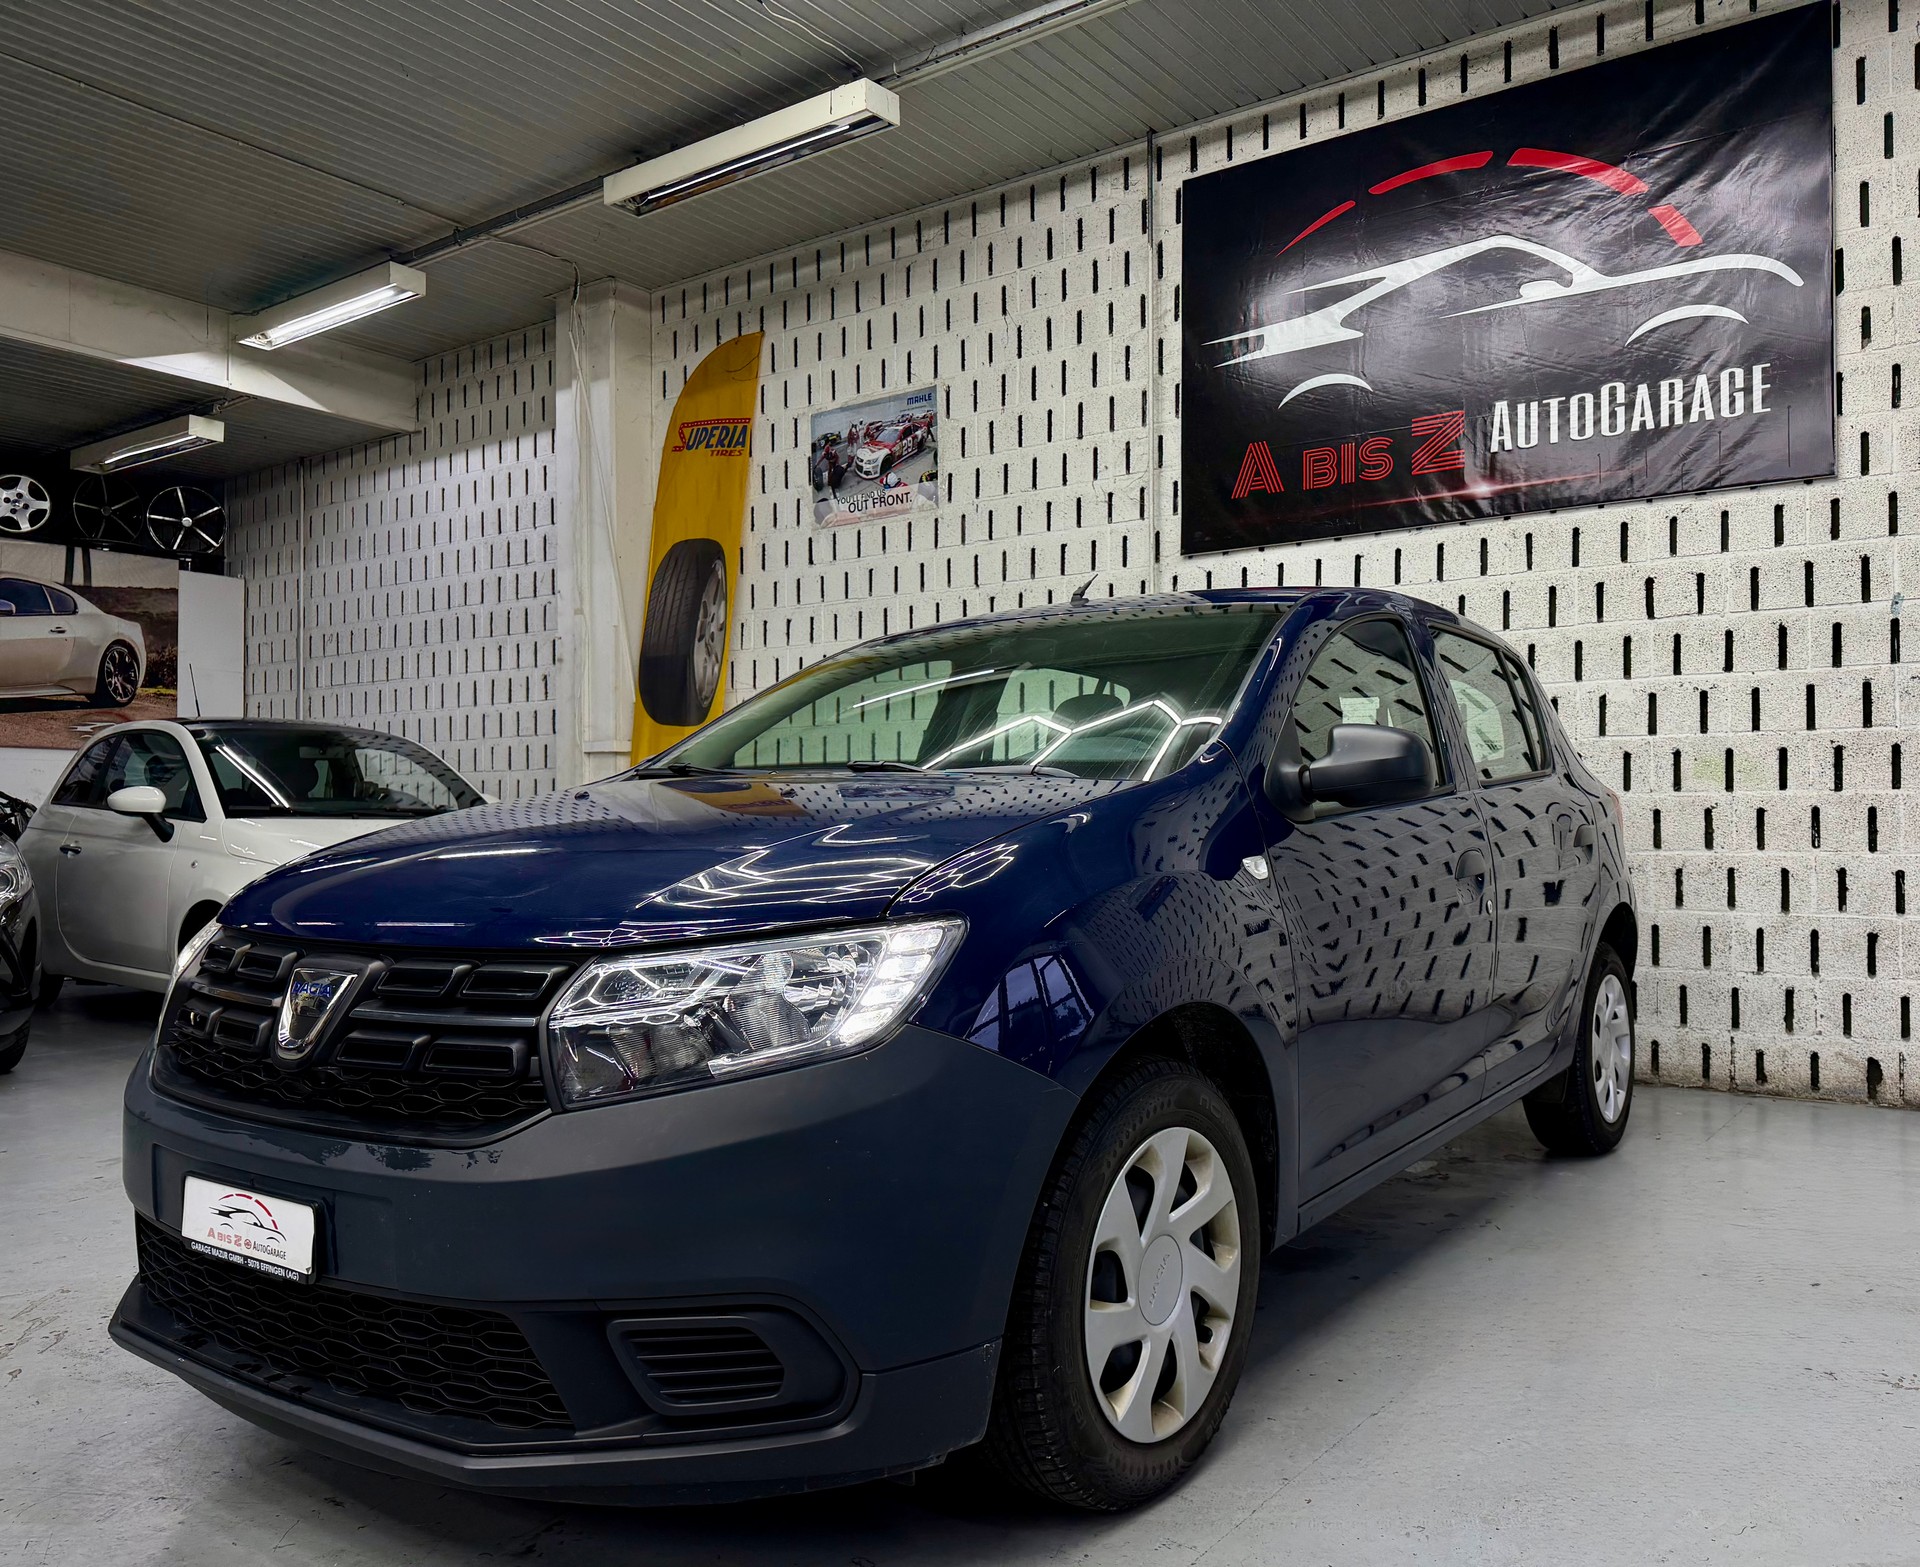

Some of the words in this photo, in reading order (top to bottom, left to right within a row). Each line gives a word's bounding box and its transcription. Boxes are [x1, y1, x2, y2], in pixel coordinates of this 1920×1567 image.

[907, 393, 932, 405] MAHLE
[672, 418, 751, 452] SUPERIA
[710, 449, 744, 457] TIRES
[1231, 441, 1284, 499] A
[1303, 437, 1393, 490] BIS
[1411, 410, 1465, 475] Z
[837, 494, 860, 505] YOULL
[848, 500, 869, 513] OUT
[873, 491, 912, 508] FRONT.
[291, 981, 332, 998] DACIA
[207, 1227, 215, 1239] A
[217, 1232, 232, 1244] BIS
[234, 1234, 242, 1247] Z
[191, 1242, 211, 1254] GARAGE
[212, 1247, 228, 1259] MAZUR
[229, 1252, 244, 1265] GMBH
[260, 1262, 286, 1277] EFFINGEN
[286, 1270, 300, 1282] (AG)
